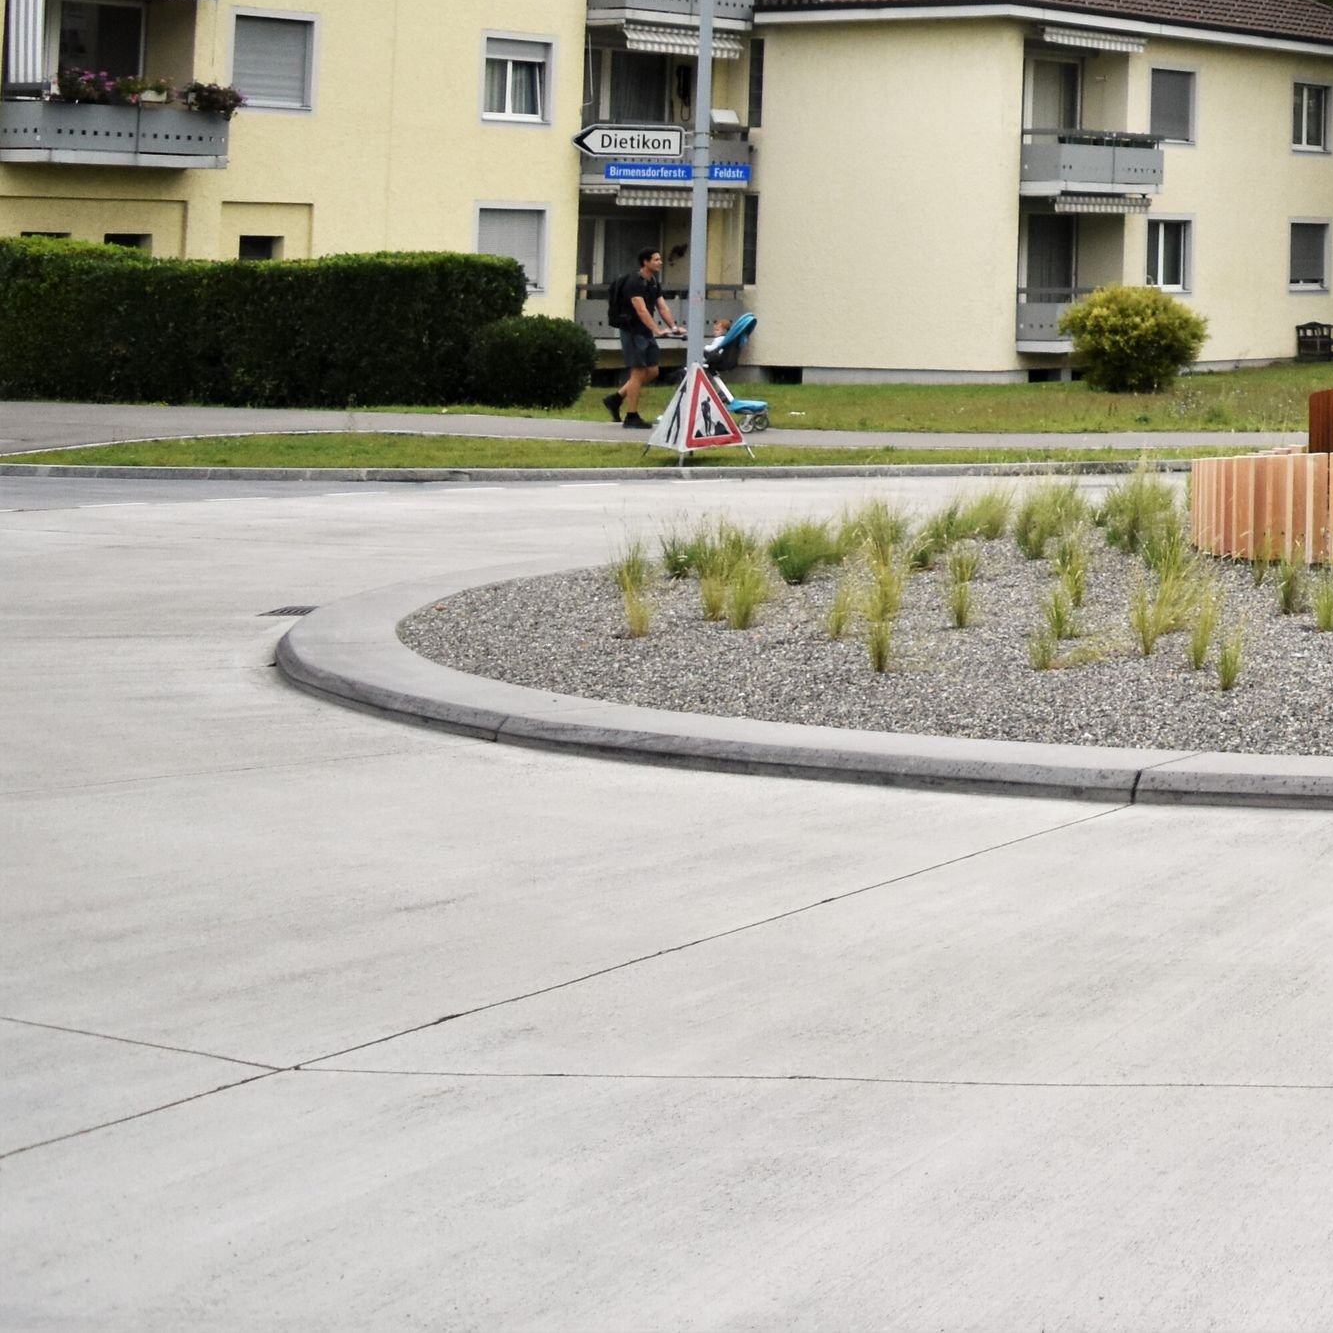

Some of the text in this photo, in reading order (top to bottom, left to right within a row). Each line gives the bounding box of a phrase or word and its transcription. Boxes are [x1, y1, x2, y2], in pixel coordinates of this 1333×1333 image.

[600, 133, 672, 150] Dietikon
[609, 165, 687, 177] Birmensdorferstr.
[713, 168, 745, 179] Feldstr.
